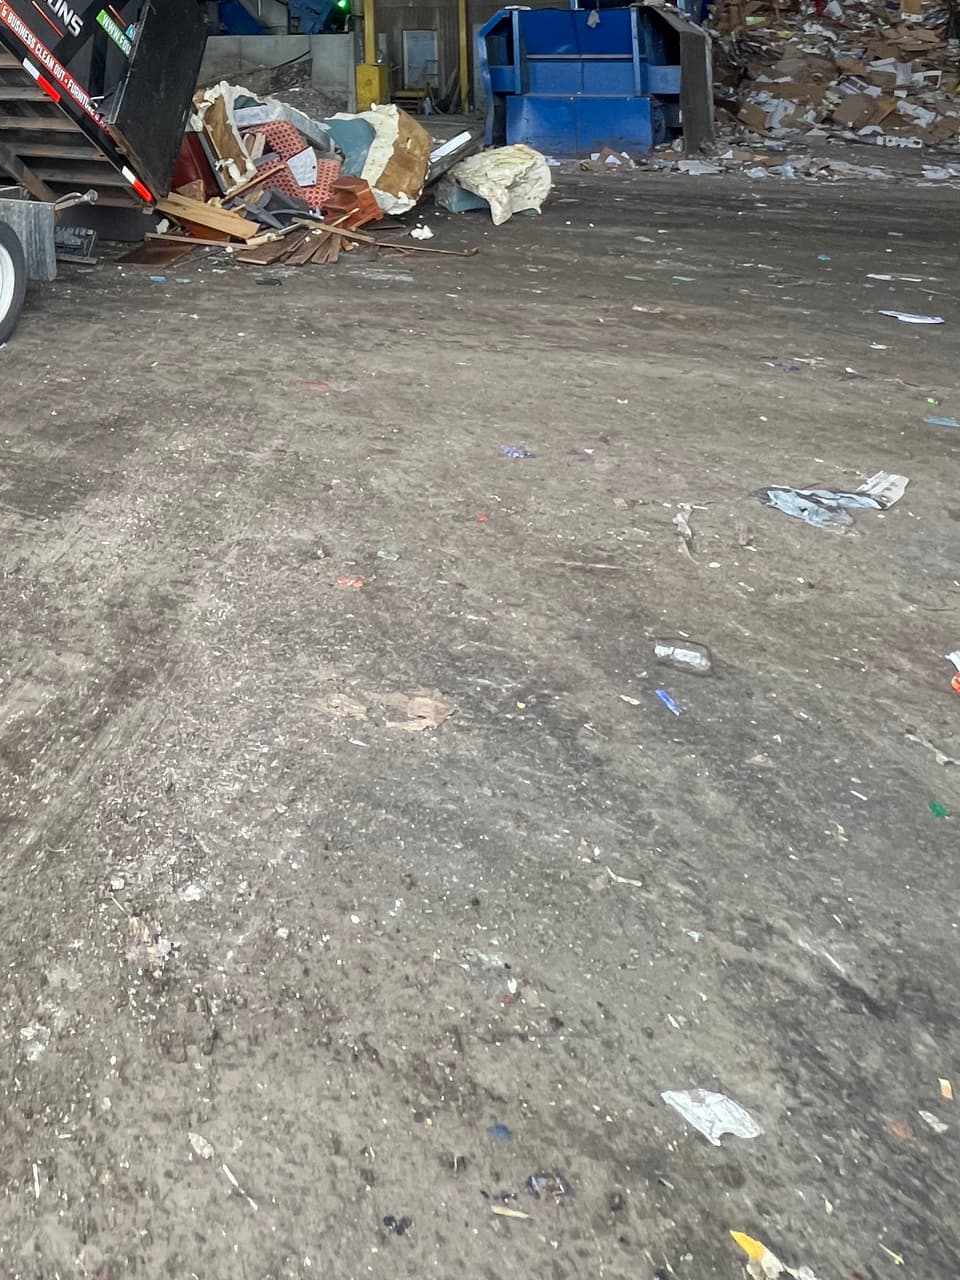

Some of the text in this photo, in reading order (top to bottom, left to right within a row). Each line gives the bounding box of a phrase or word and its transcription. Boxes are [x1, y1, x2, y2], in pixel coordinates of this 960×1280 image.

[7, 13, 36, 49] BUSINESS
[35, 43, 54, 71] CLEAN
[53, 63, 66, 82] OUT
